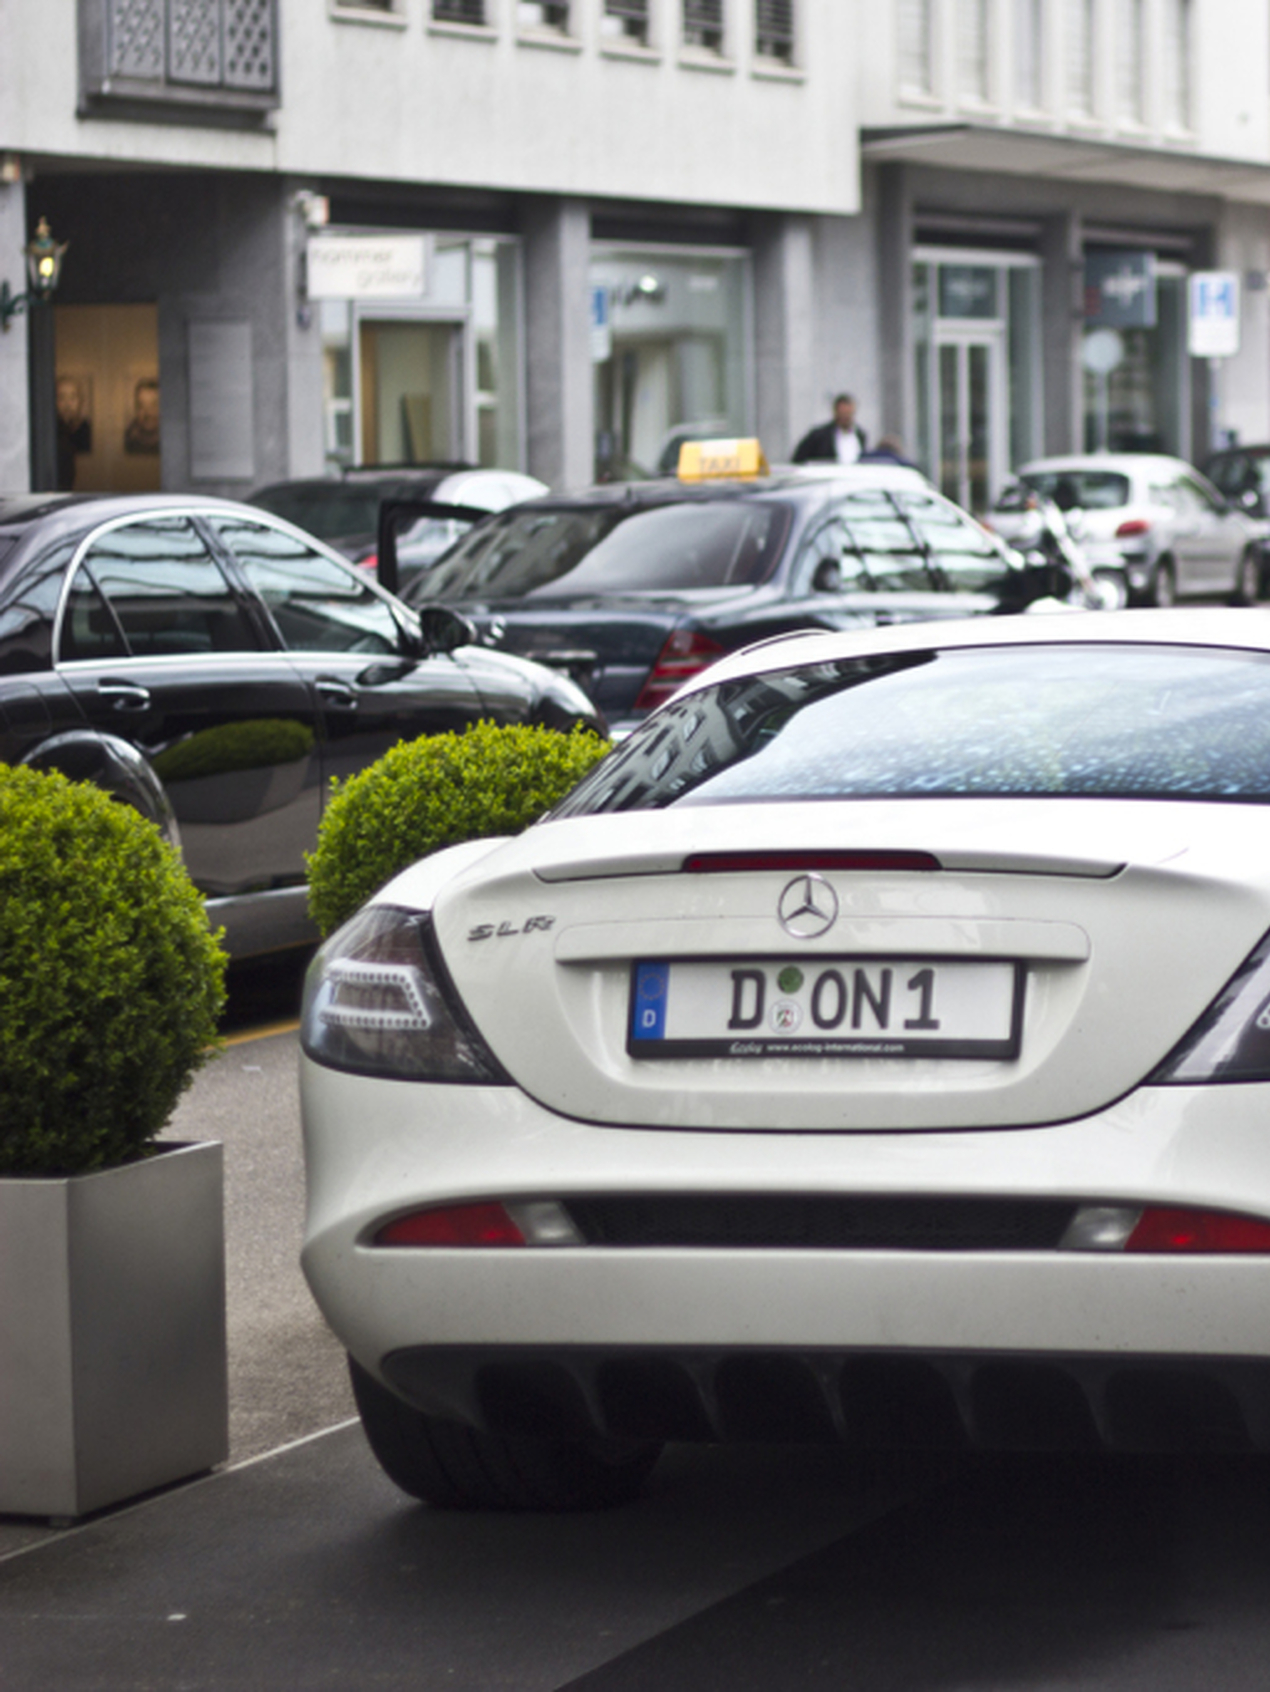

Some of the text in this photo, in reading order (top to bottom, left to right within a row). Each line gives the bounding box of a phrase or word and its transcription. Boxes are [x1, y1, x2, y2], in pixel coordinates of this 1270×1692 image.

[698, 457, 742, 473] TAXI
[467, 915, 556, 941] SLR
[727, 969, 767, 1030] D
[642, 1009, 656, 1027] D
[766, 1041, 905, 1055] www.ecolog-international.com
